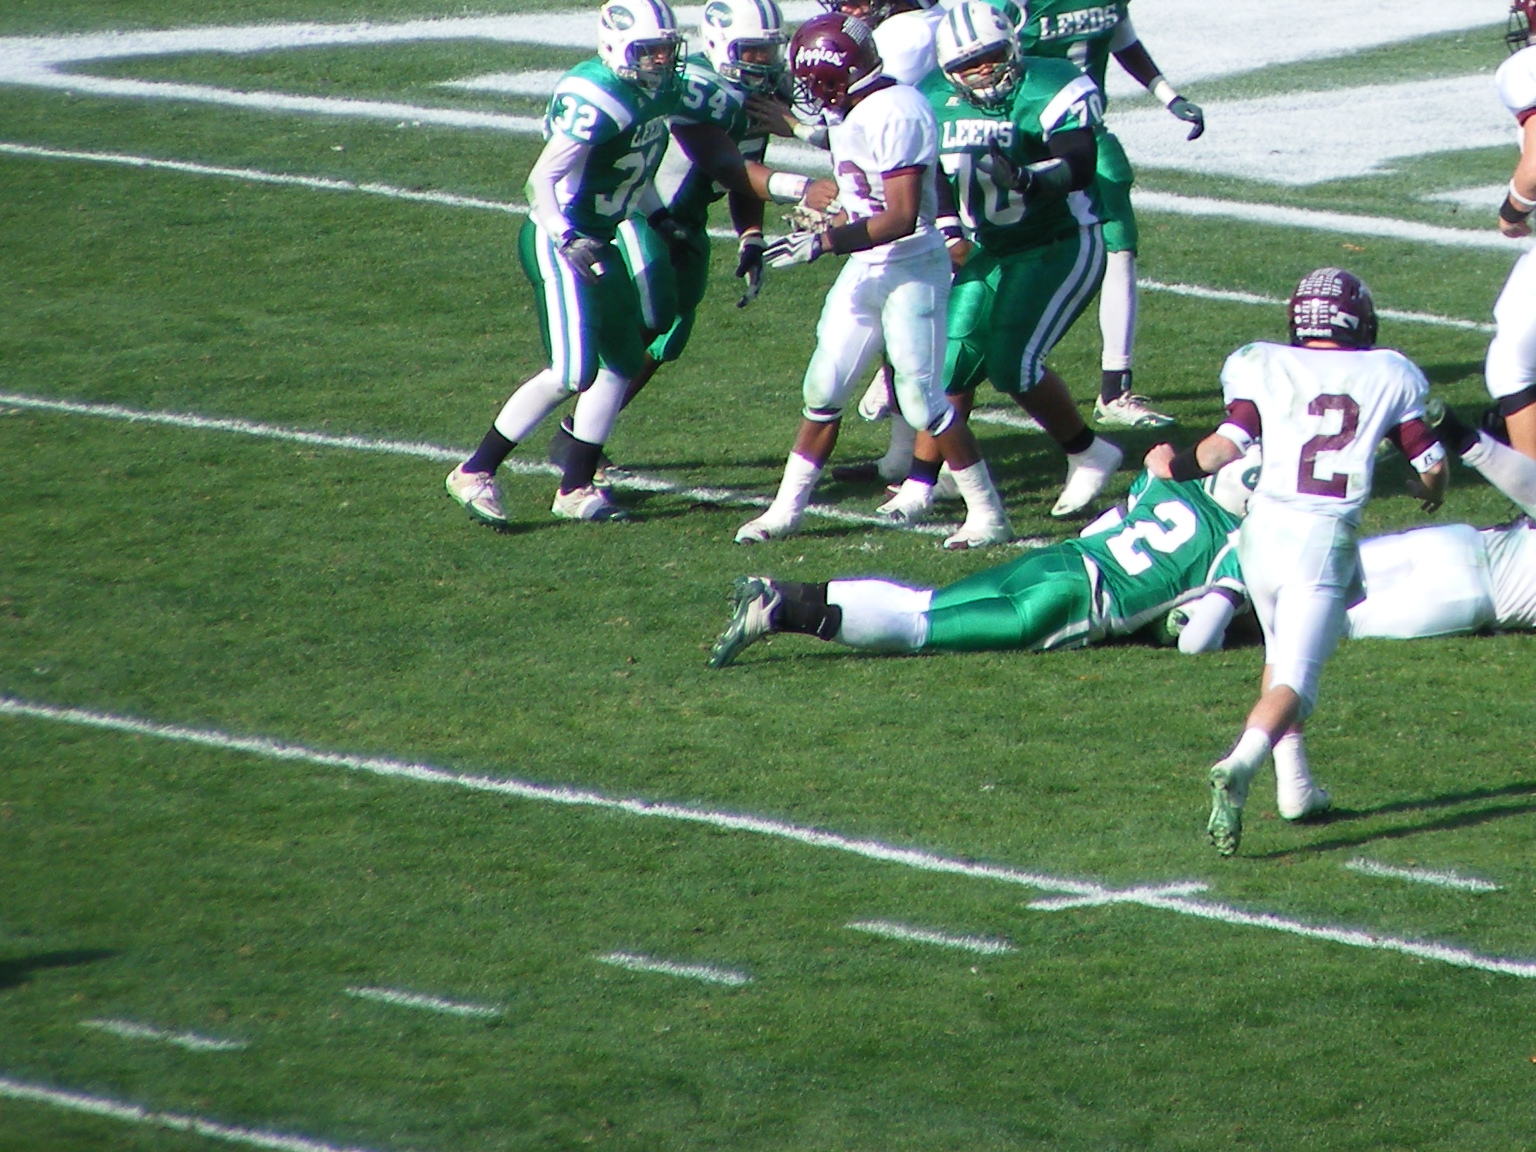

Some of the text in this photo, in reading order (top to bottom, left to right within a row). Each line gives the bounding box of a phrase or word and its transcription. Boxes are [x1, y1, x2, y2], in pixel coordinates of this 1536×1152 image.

[1040, 4, 1119, 40] LEEDS
[796, 46, 848, 69] Aggies
[554, 96, 598, 141] 32
[682, 74, 730, 120] 54
[942, 119, 1014, 148] LEEDS
[1297, 393, 1361, 499] 2
[1106, 500, 1197, 576] 2
